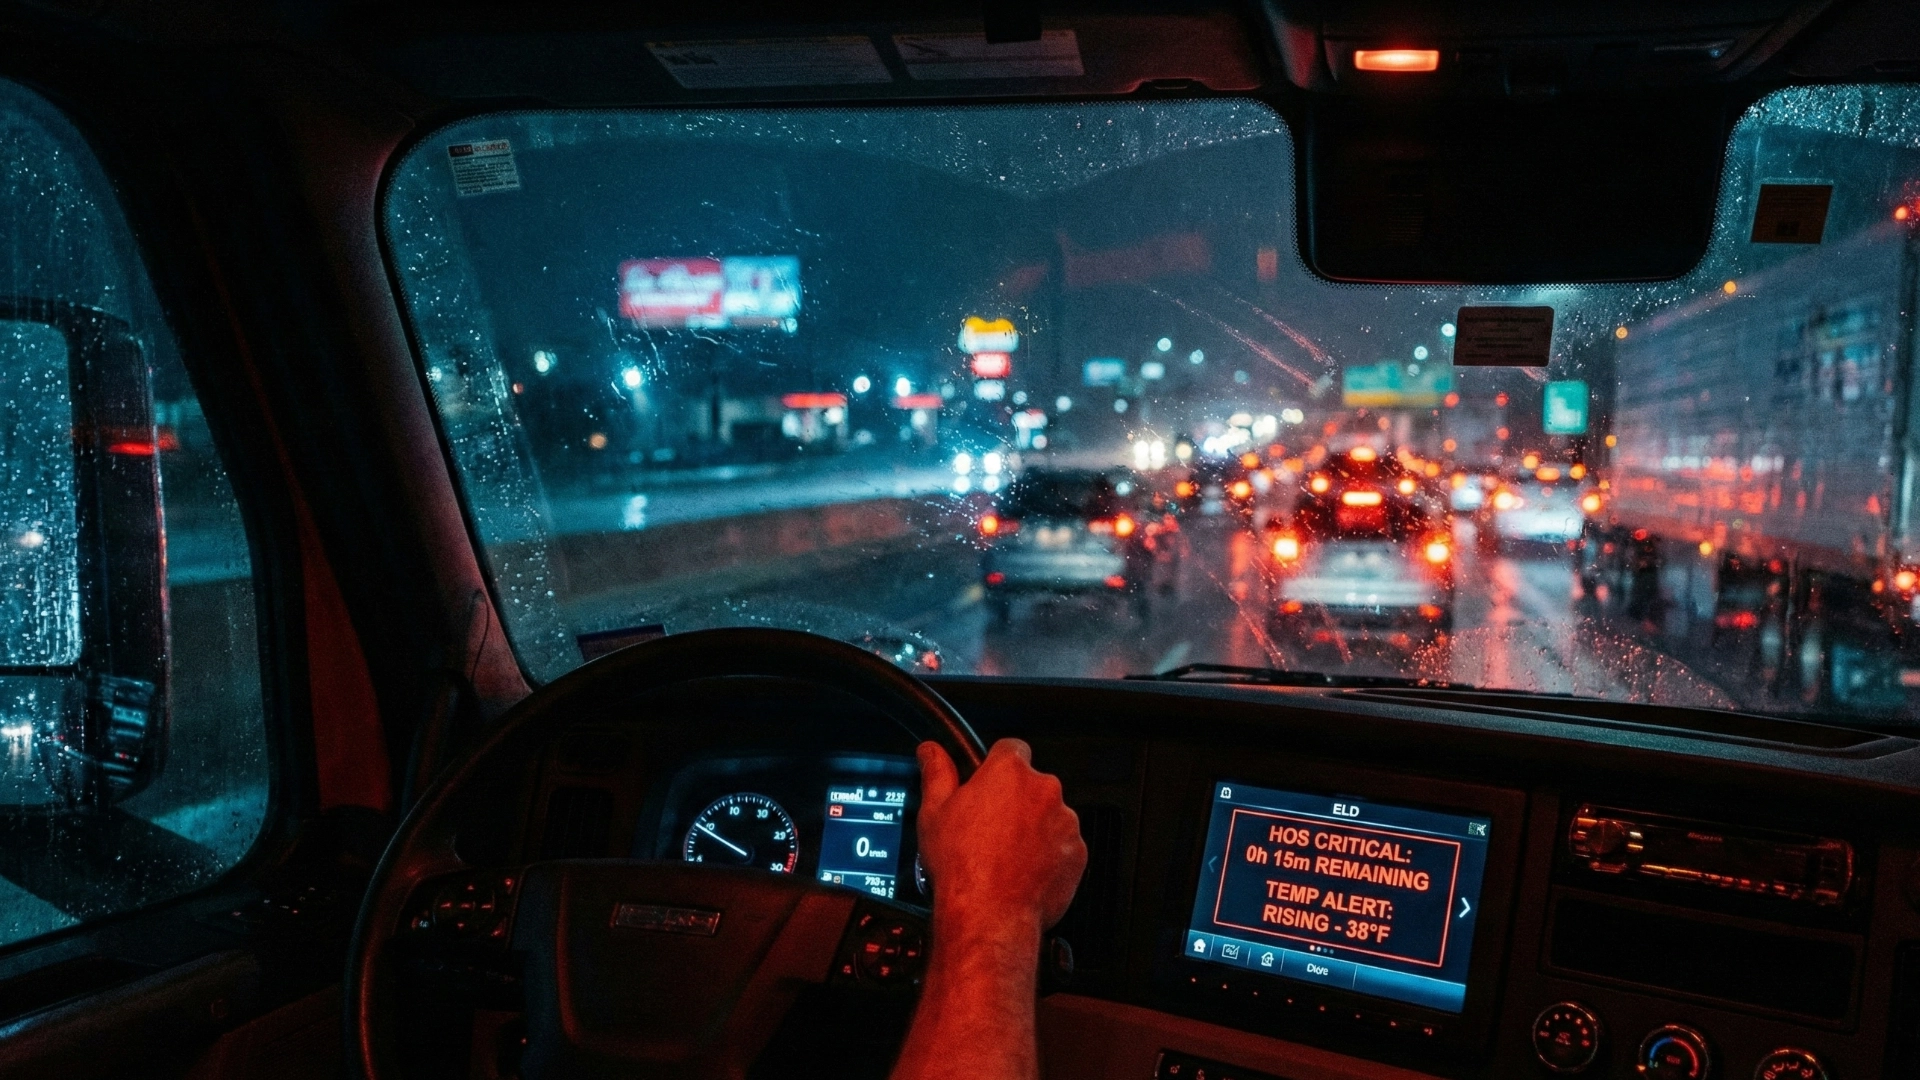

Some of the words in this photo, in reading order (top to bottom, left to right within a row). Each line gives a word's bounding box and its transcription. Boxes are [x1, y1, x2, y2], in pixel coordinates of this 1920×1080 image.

[729, 806, 740, 816] 10
[1332, 803, 1360, 818] ELD
[856, 836, 870, 857] 0
[1269, 825, 1310, 847] HOS
[1314, 832, 1412, 863] CRITICAL:
[1246, 845, 1268, 865] 0h
[1273, 850, 1310, 871] 15m
[1315, 856, 1430, 891] REMAINING
[1266, 880, 1320, 904] TEMP
[1321, 891, 1393, 920] ALERT:
[1263, 904, 1329, 933] RISING
[1346, 919, 1391, 943] 38°F
